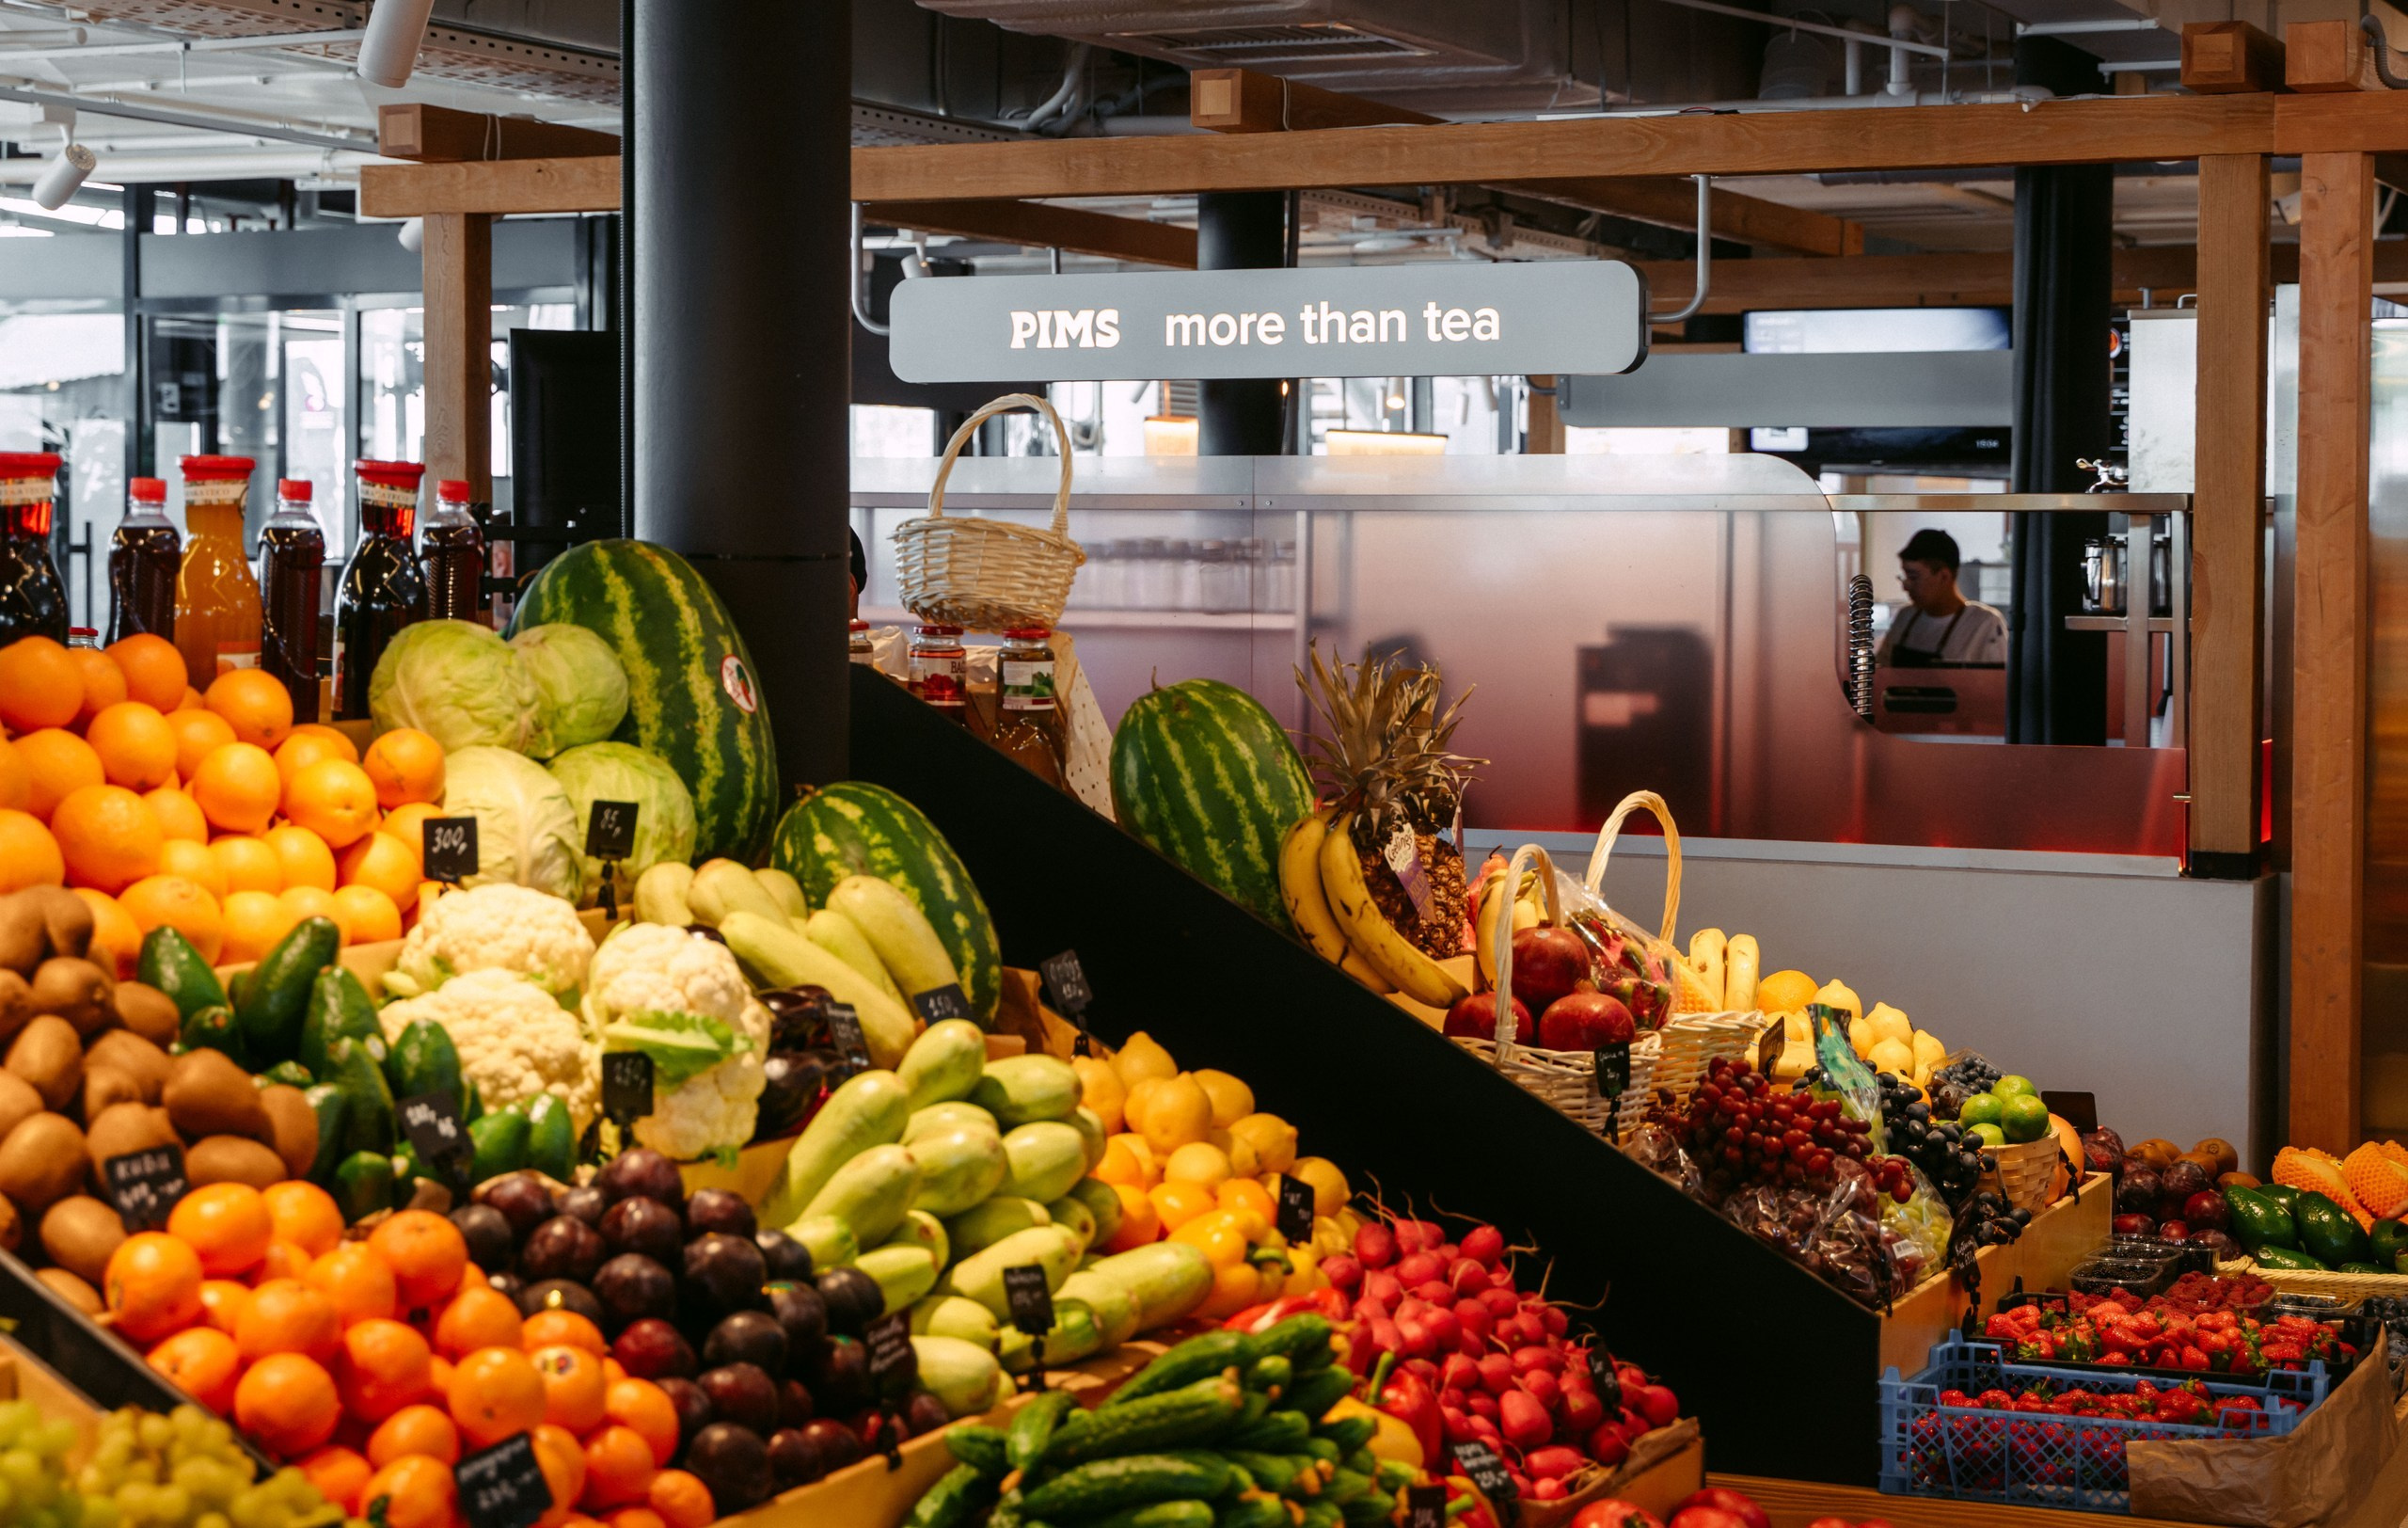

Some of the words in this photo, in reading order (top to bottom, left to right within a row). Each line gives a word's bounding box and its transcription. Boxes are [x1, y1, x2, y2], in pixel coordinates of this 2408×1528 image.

[1009, 308, 1121, 349] PIMS
[1165, 311, 1286, 347] more
[1299, 300, 1407, 345] than
[1422, 301, 1500, 342] tea
[1386, 833, 1414, 863] Keelings
